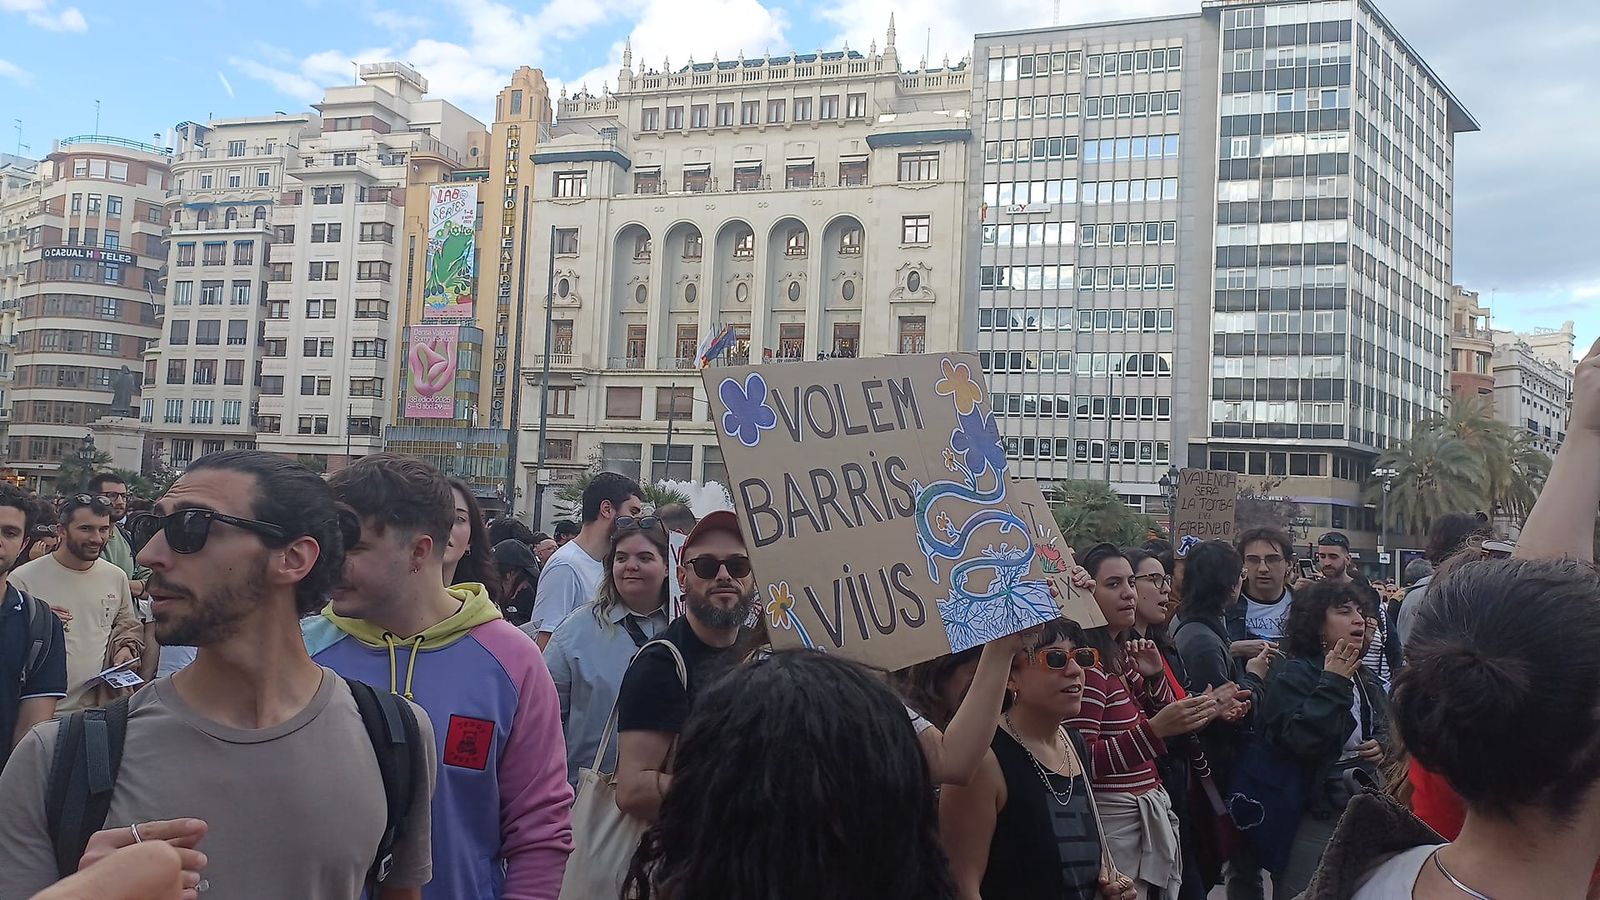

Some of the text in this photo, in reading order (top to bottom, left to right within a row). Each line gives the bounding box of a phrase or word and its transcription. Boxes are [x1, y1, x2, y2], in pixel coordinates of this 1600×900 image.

[504, 138, 519, 210] RIALTO
[500, 225, 513, 297] TEATRE
[491, 312, 508, 429] FILMOTECA
[1181, 498, 1196, 510] LA
